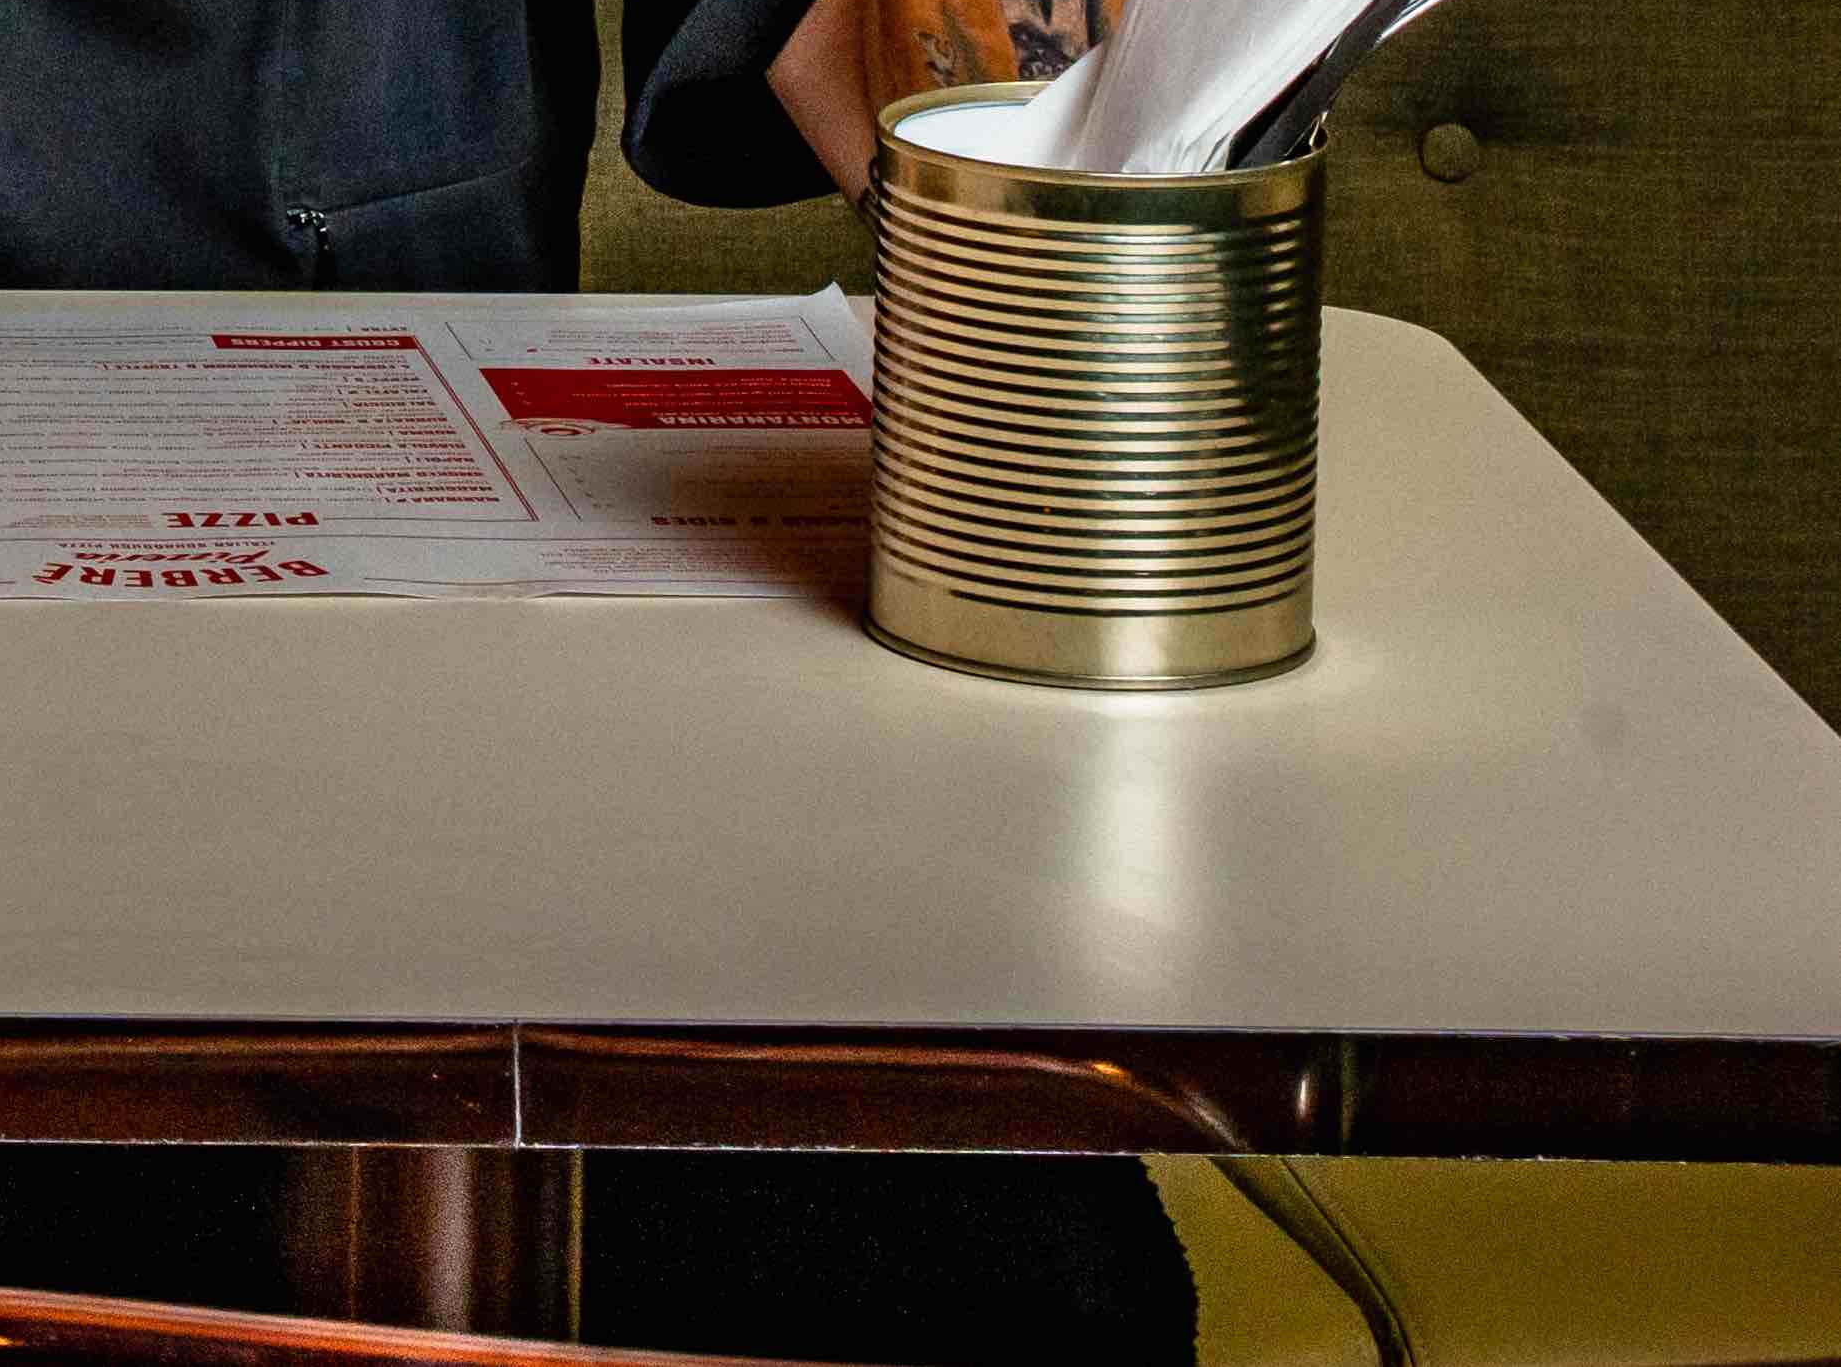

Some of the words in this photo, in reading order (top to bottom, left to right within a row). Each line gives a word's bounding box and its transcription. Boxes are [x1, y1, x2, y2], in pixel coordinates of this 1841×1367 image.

[230, 338, 321, 347] DIPPERS
[330, 339, 399, 347] CRUST
[657, 415, 865, 426] MONTANARINA
[161, 512, 320, 529] PIZZE
[74, 550, 270, 564] Pizzeria
